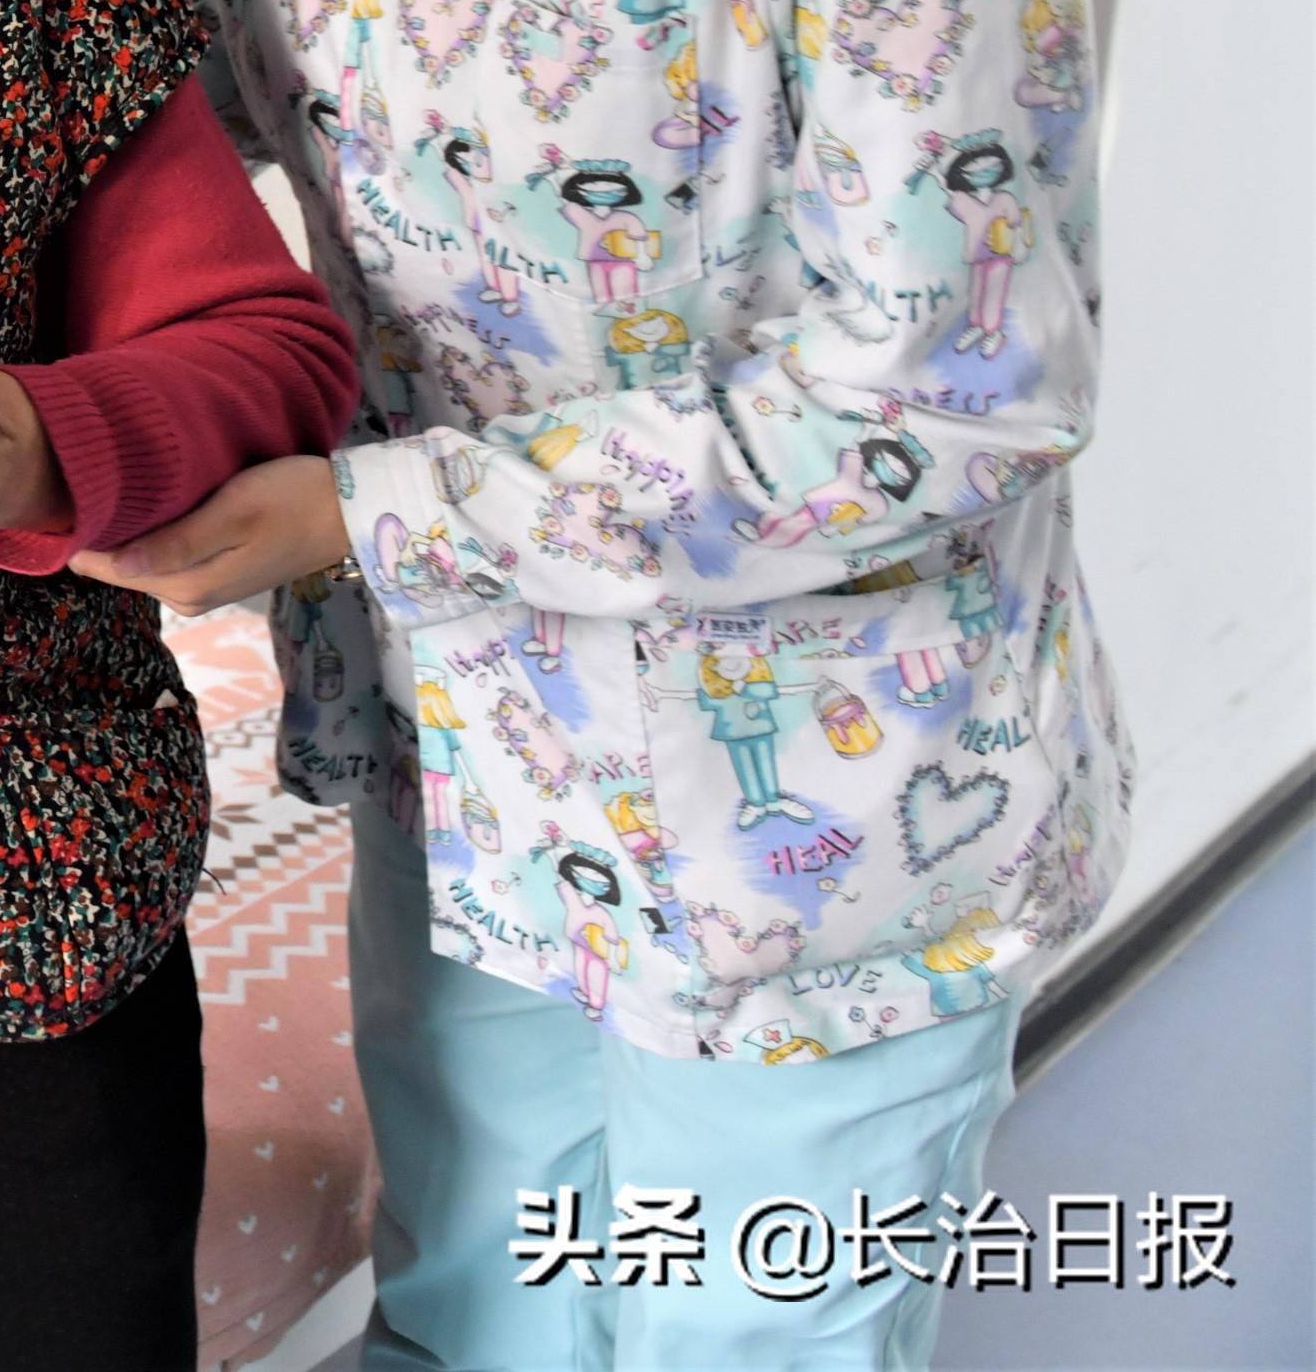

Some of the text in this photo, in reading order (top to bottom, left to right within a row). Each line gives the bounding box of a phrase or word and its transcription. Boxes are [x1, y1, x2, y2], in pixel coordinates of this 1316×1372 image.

[357, 178, 463, 252] HEALTH
[763, 826, 864, 876] HEAL
[448, 878, 560, 953] HEALTH
[787, 961, 884, 996] LOVE
